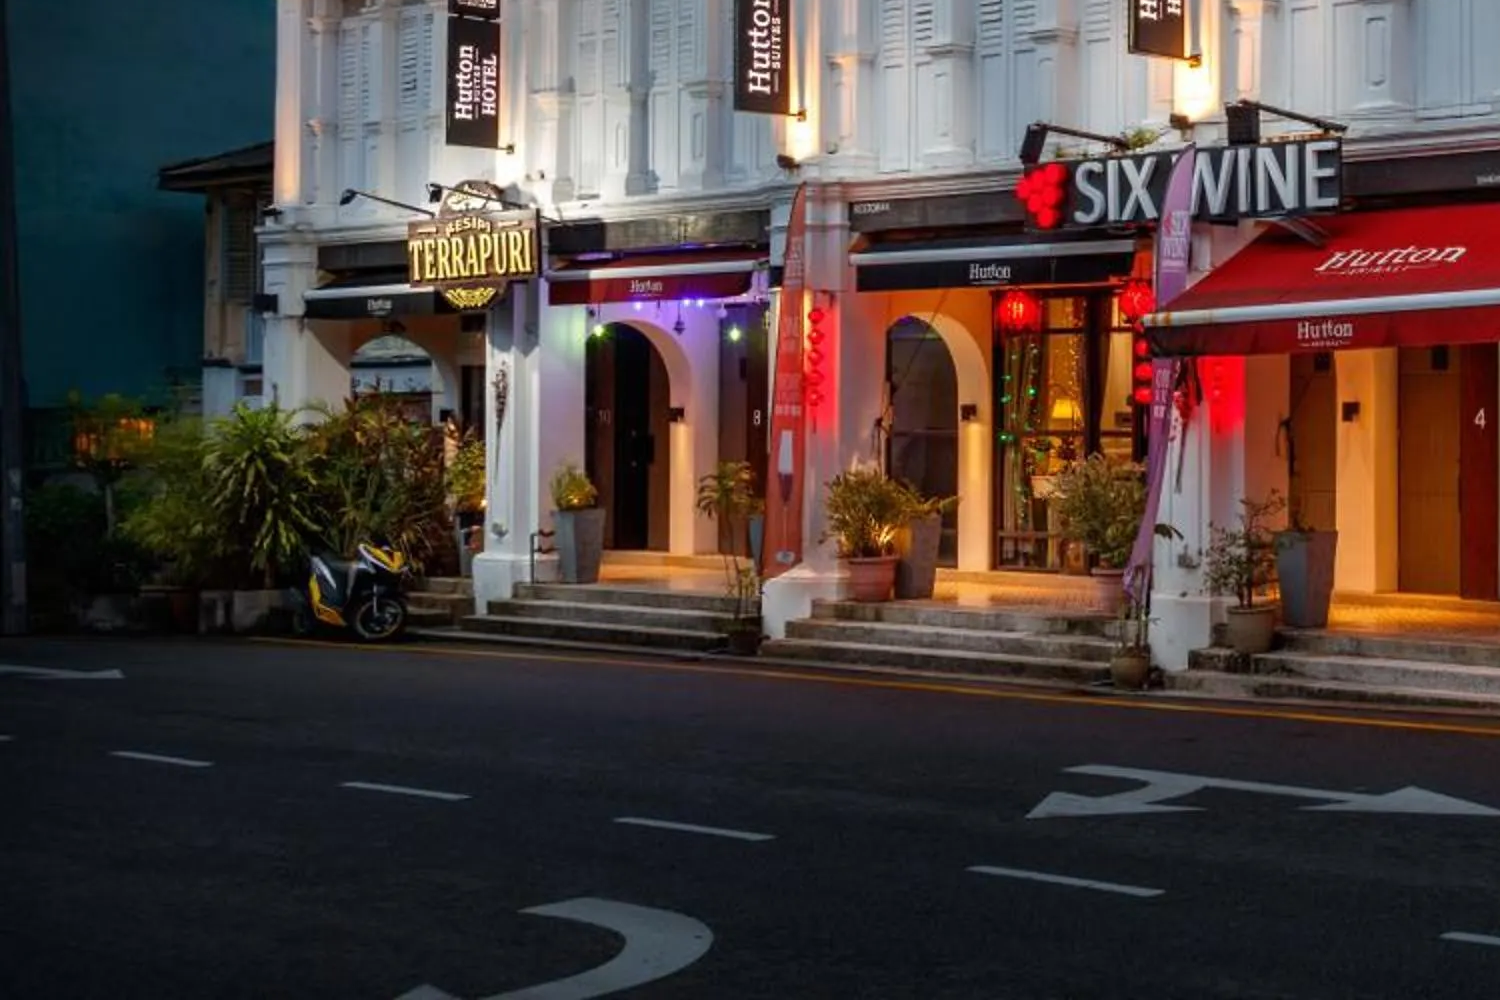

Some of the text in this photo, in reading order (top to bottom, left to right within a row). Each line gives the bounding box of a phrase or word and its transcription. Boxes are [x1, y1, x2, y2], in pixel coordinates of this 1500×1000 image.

[772, 17, 781, 69] SUITES
[455, 45, 473, 120] Hutton
[481, 54, 497, 116] HOTEL
[1074, 140, 1339, 223] SIX WINE
[409, 229, 532, 281] TERRAPURI
[969, 263, 1011, 280] Hutton
[1314, 245, 1467, 272] Hutton
[1297, 319, 1354, 339] Hutton
[753, 410, 761, 425] 8
[1474, 407, 1486, 430] 4
